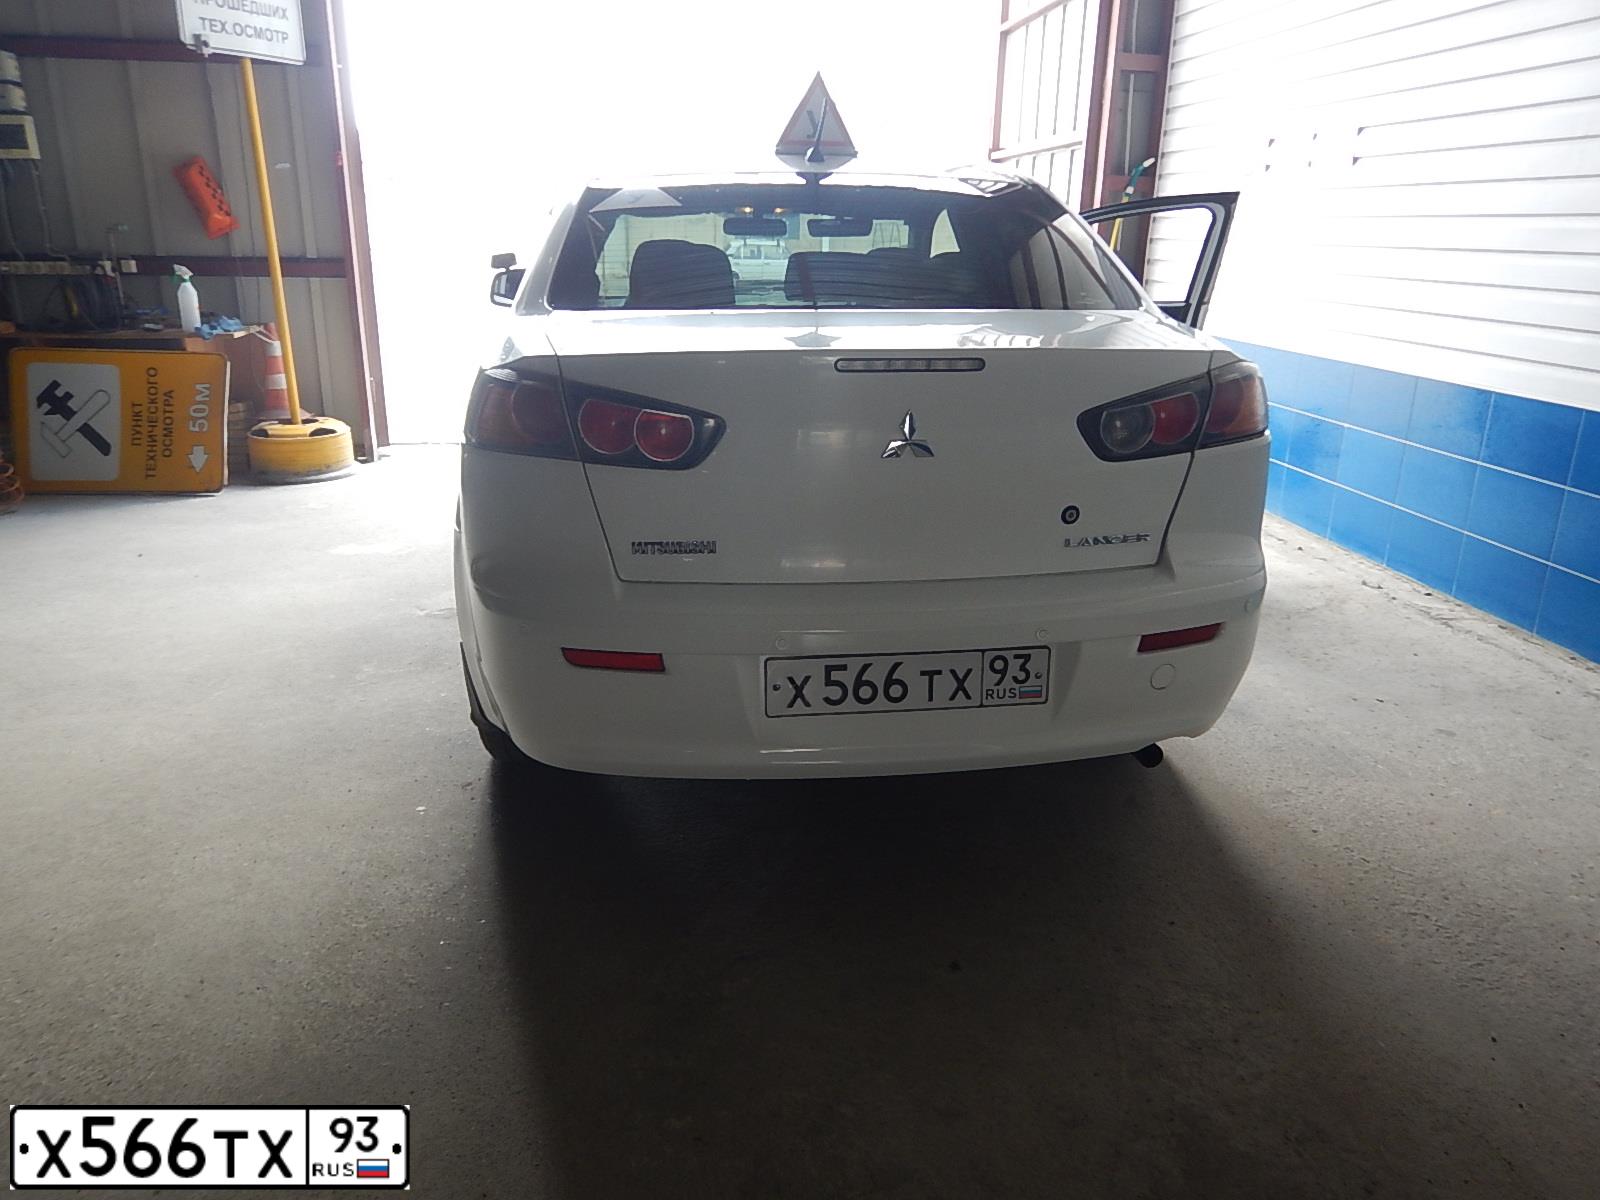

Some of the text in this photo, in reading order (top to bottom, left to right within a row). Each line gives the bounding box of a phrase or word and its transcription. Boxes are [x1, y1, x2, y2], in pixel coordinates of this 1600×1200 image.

[194, 0, 289, 20] ОШЕДШИХ
[198, 16, 289, 44] ТЕХ.ОСМОТР
[131, 402, 143, 447] ПУНКТ
[145, 366, 158, 479] ТЕХНИЧЕСКОГО
[163, 390, 175, 458] ОСМОТРА
[988, 653, 1032, 687] 93
[985, 687, 1017, 700] RUS
